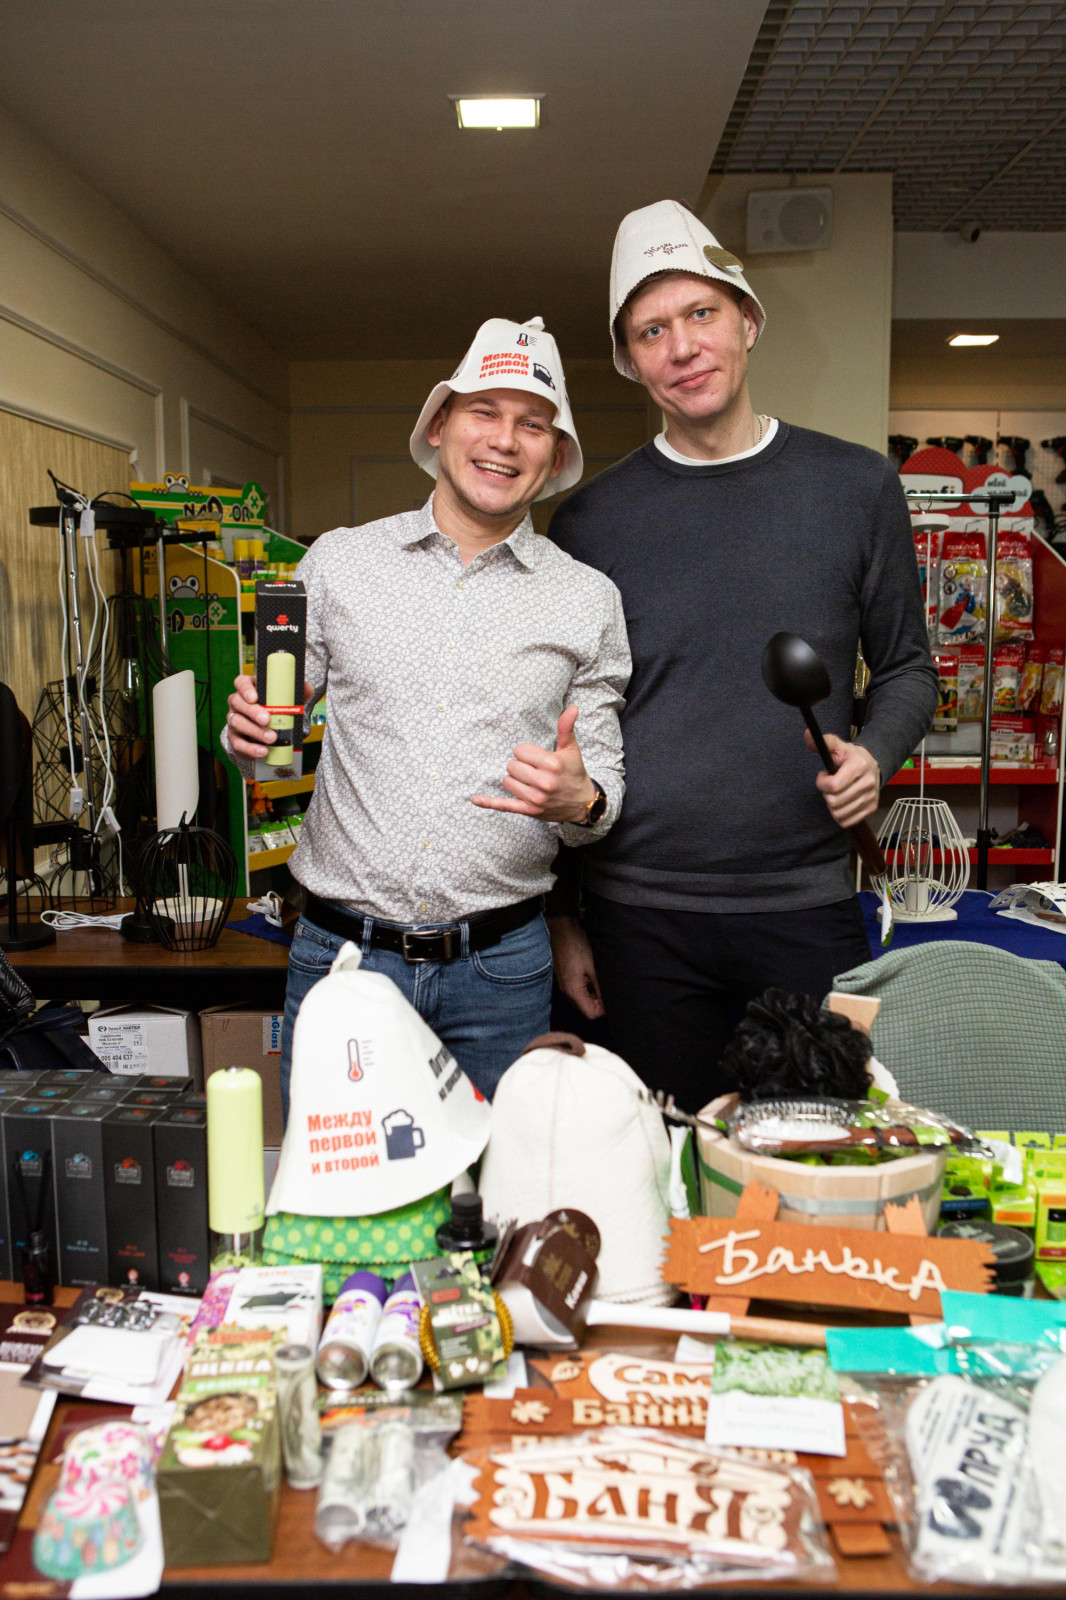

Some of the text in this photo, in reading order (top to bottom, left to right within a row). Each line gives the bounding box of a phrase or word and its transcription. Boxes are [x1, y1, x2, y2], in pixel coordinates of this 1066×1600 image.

[480, 359, 530, 371] первой
[482, 352, 530, 364] Между
[488, 368, 529, 376] второй
[265, 623, 299, 633] qwerty
[307, 1109, 373, 1133] Между
[309, 1127, 378, 1154] первой
[311, 1151, 380, 1175] и второй
[613, 1364, 712, 1387] Сам
